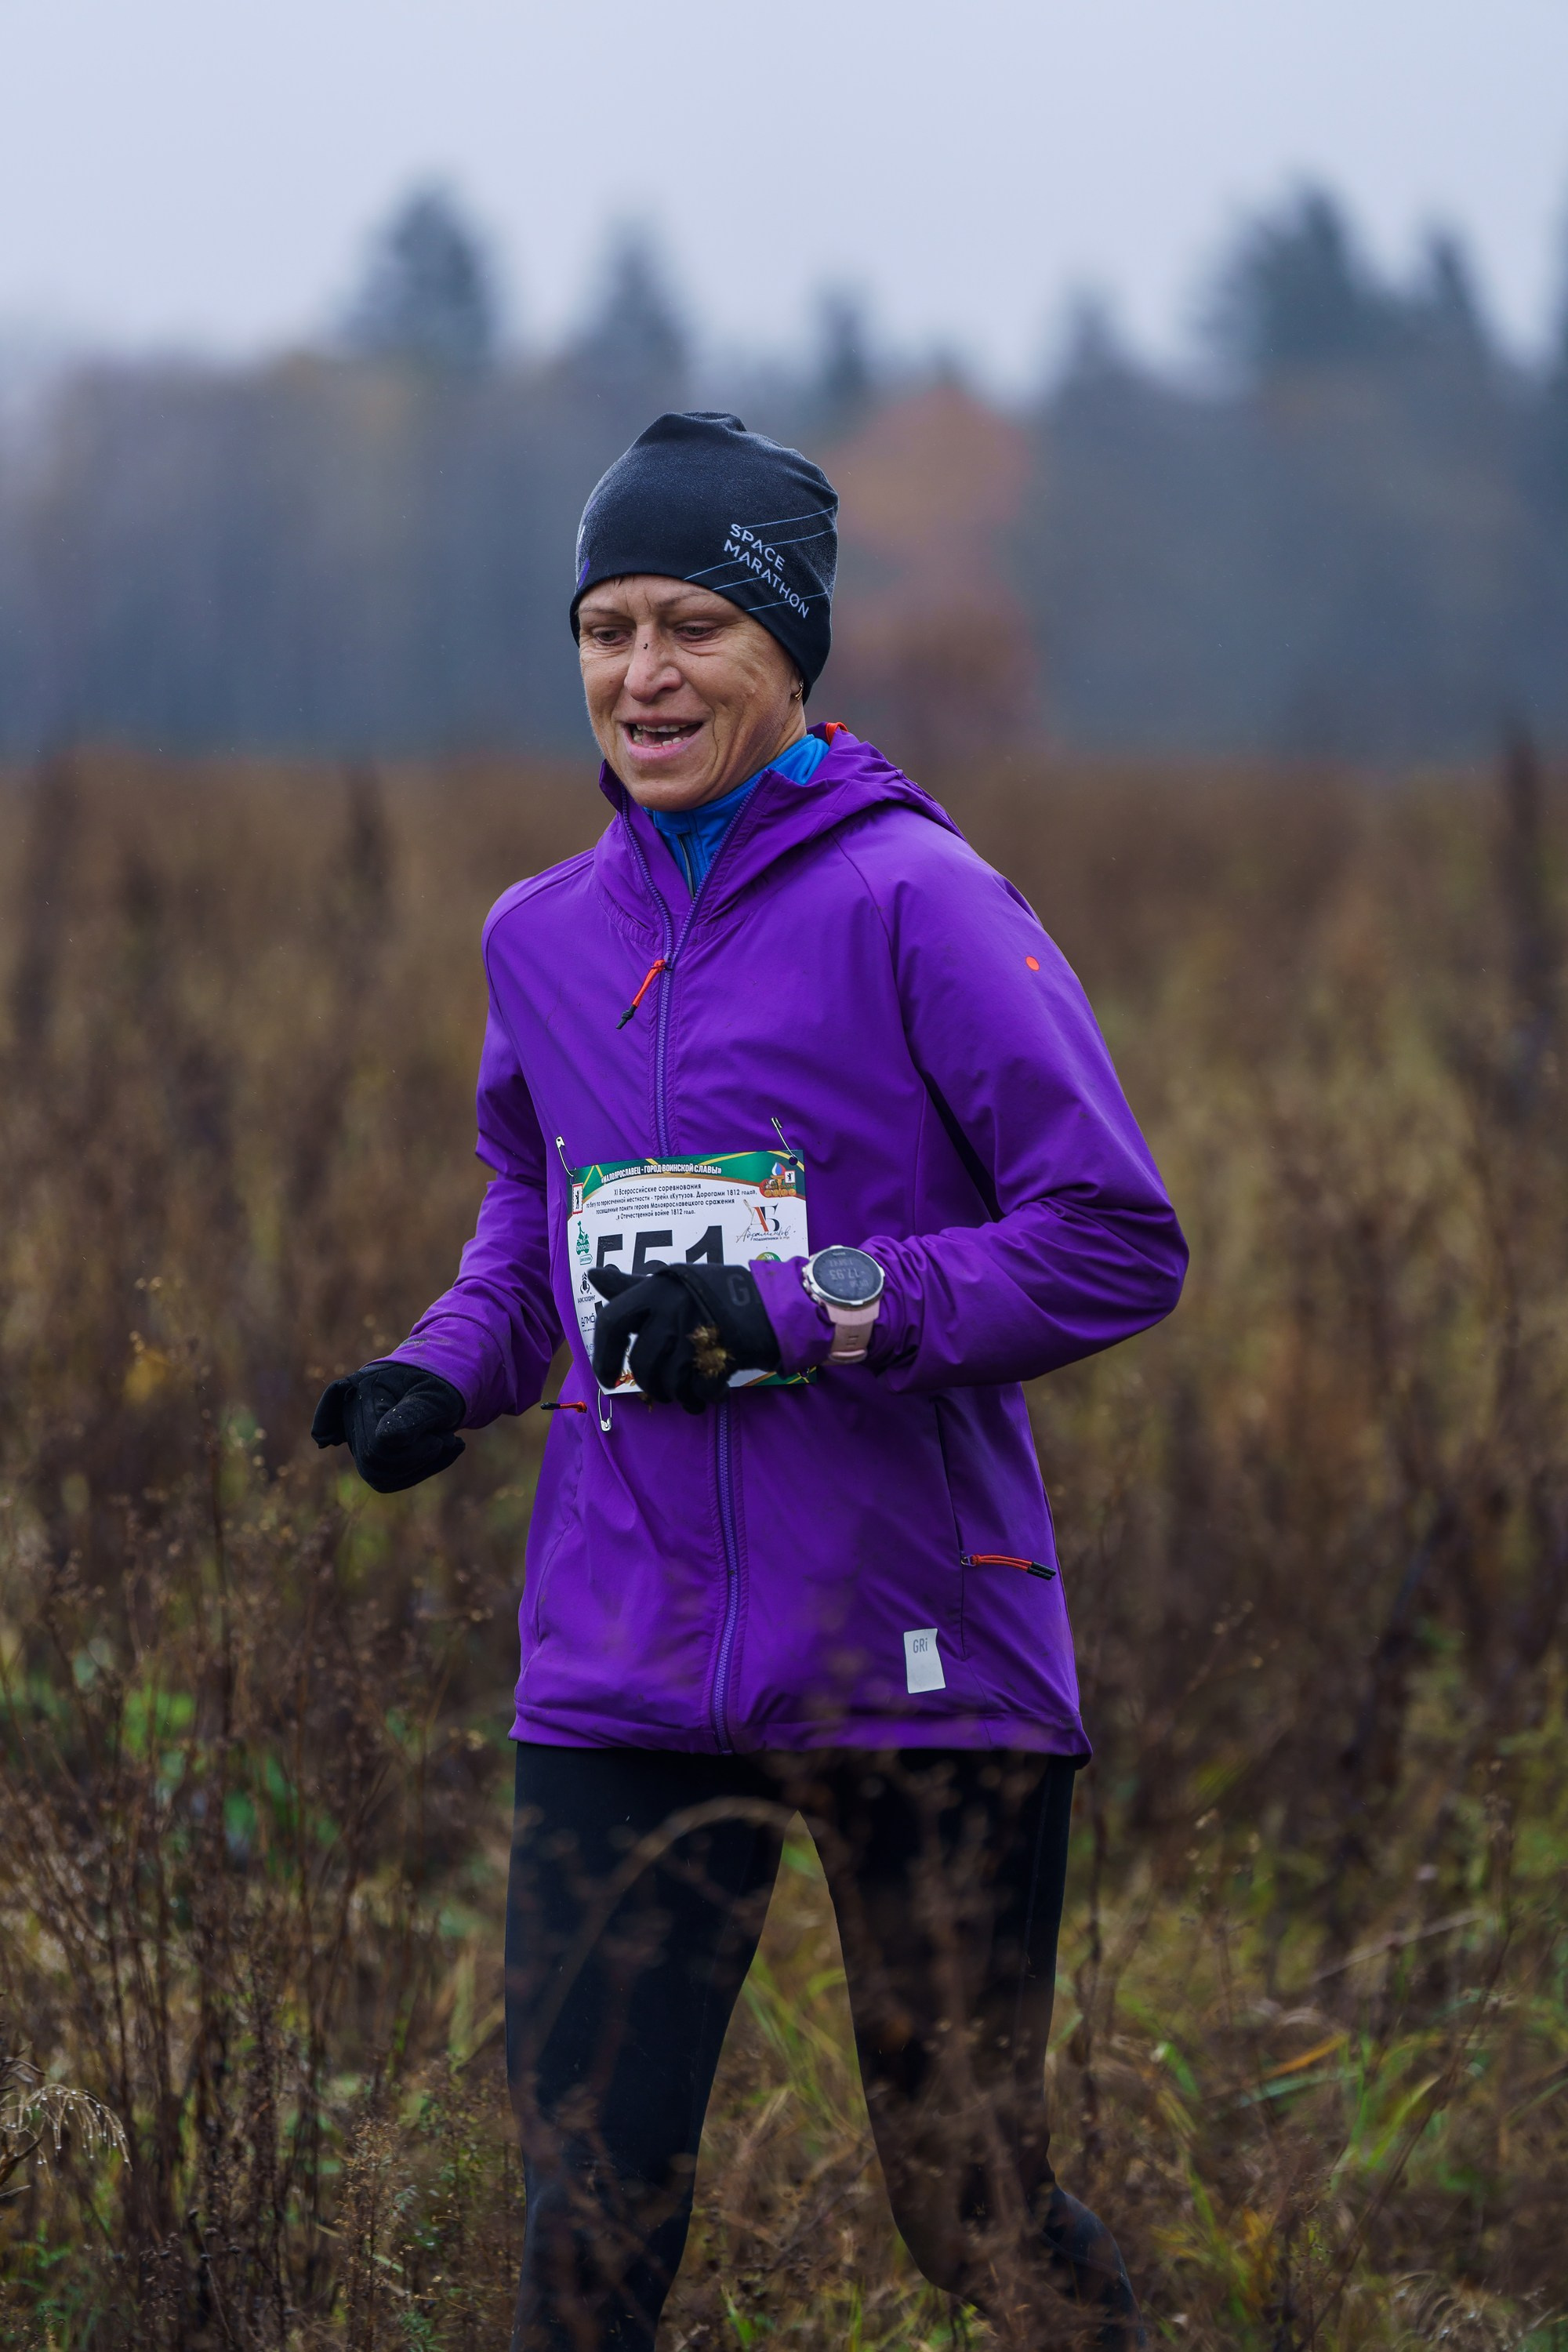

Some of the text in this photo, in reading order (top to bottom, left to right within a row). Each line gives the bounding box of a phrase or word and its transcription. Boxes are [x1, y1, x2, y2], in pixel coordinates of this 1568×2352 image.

[730, 523, 785, 571] SPACE
[724, 539, 809, 619] MARATHON
[644, 1163, 662, 1174] ГОРОД
[662, 1163, 694, 1174] ВОИНСКОЙ
[694, 1163, 722, 1174] СЛАВЫ»
[619, 1186, 657, 1196] Всероссийские
[658, 1184, 702, 1193] соревнования
[650, 1200, 704, 1209] Малоярославецкого
[705, 1198, 735, 1207] сражения
[620, 1210, 654, 1220] Отечественной
